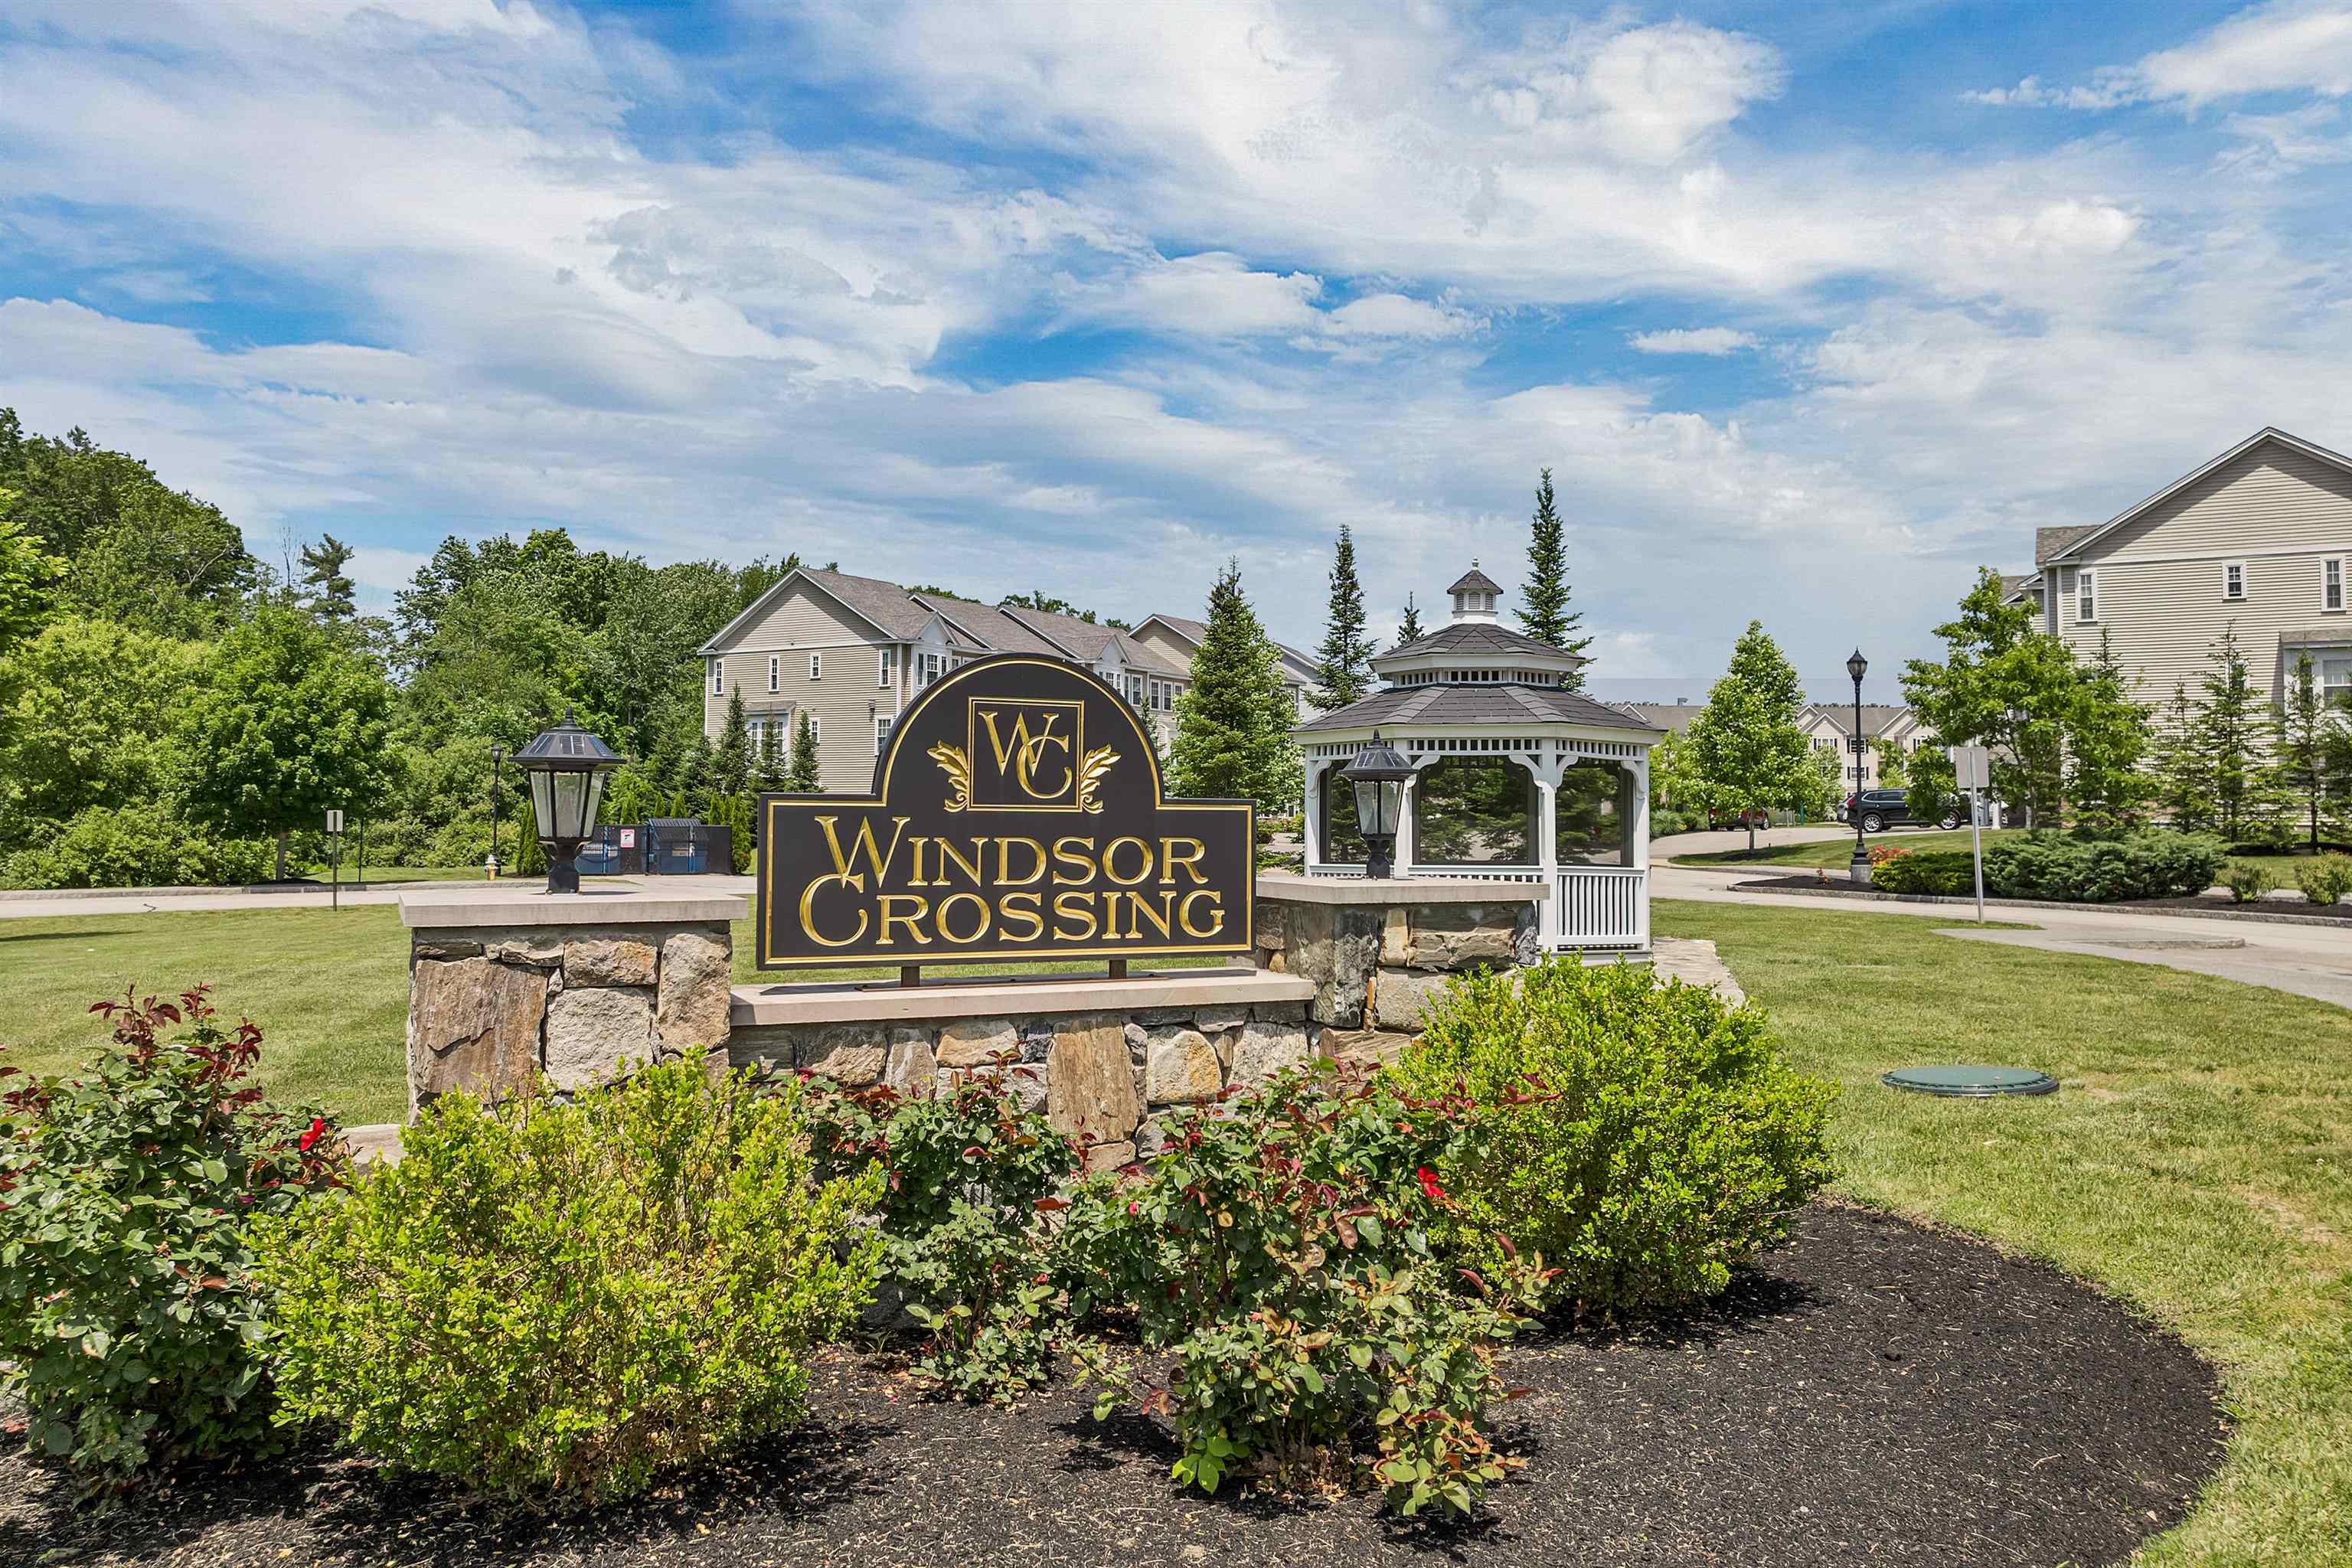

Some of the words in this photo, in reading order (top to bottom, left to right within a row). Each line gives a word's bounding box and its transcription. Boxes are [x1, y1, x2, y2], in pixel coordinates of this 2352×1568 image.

[978, 711, 1073, 799] WC
[815, 815, 1209, 889] WINDSOR
[799, 874, 1226, 947] CROSSING
